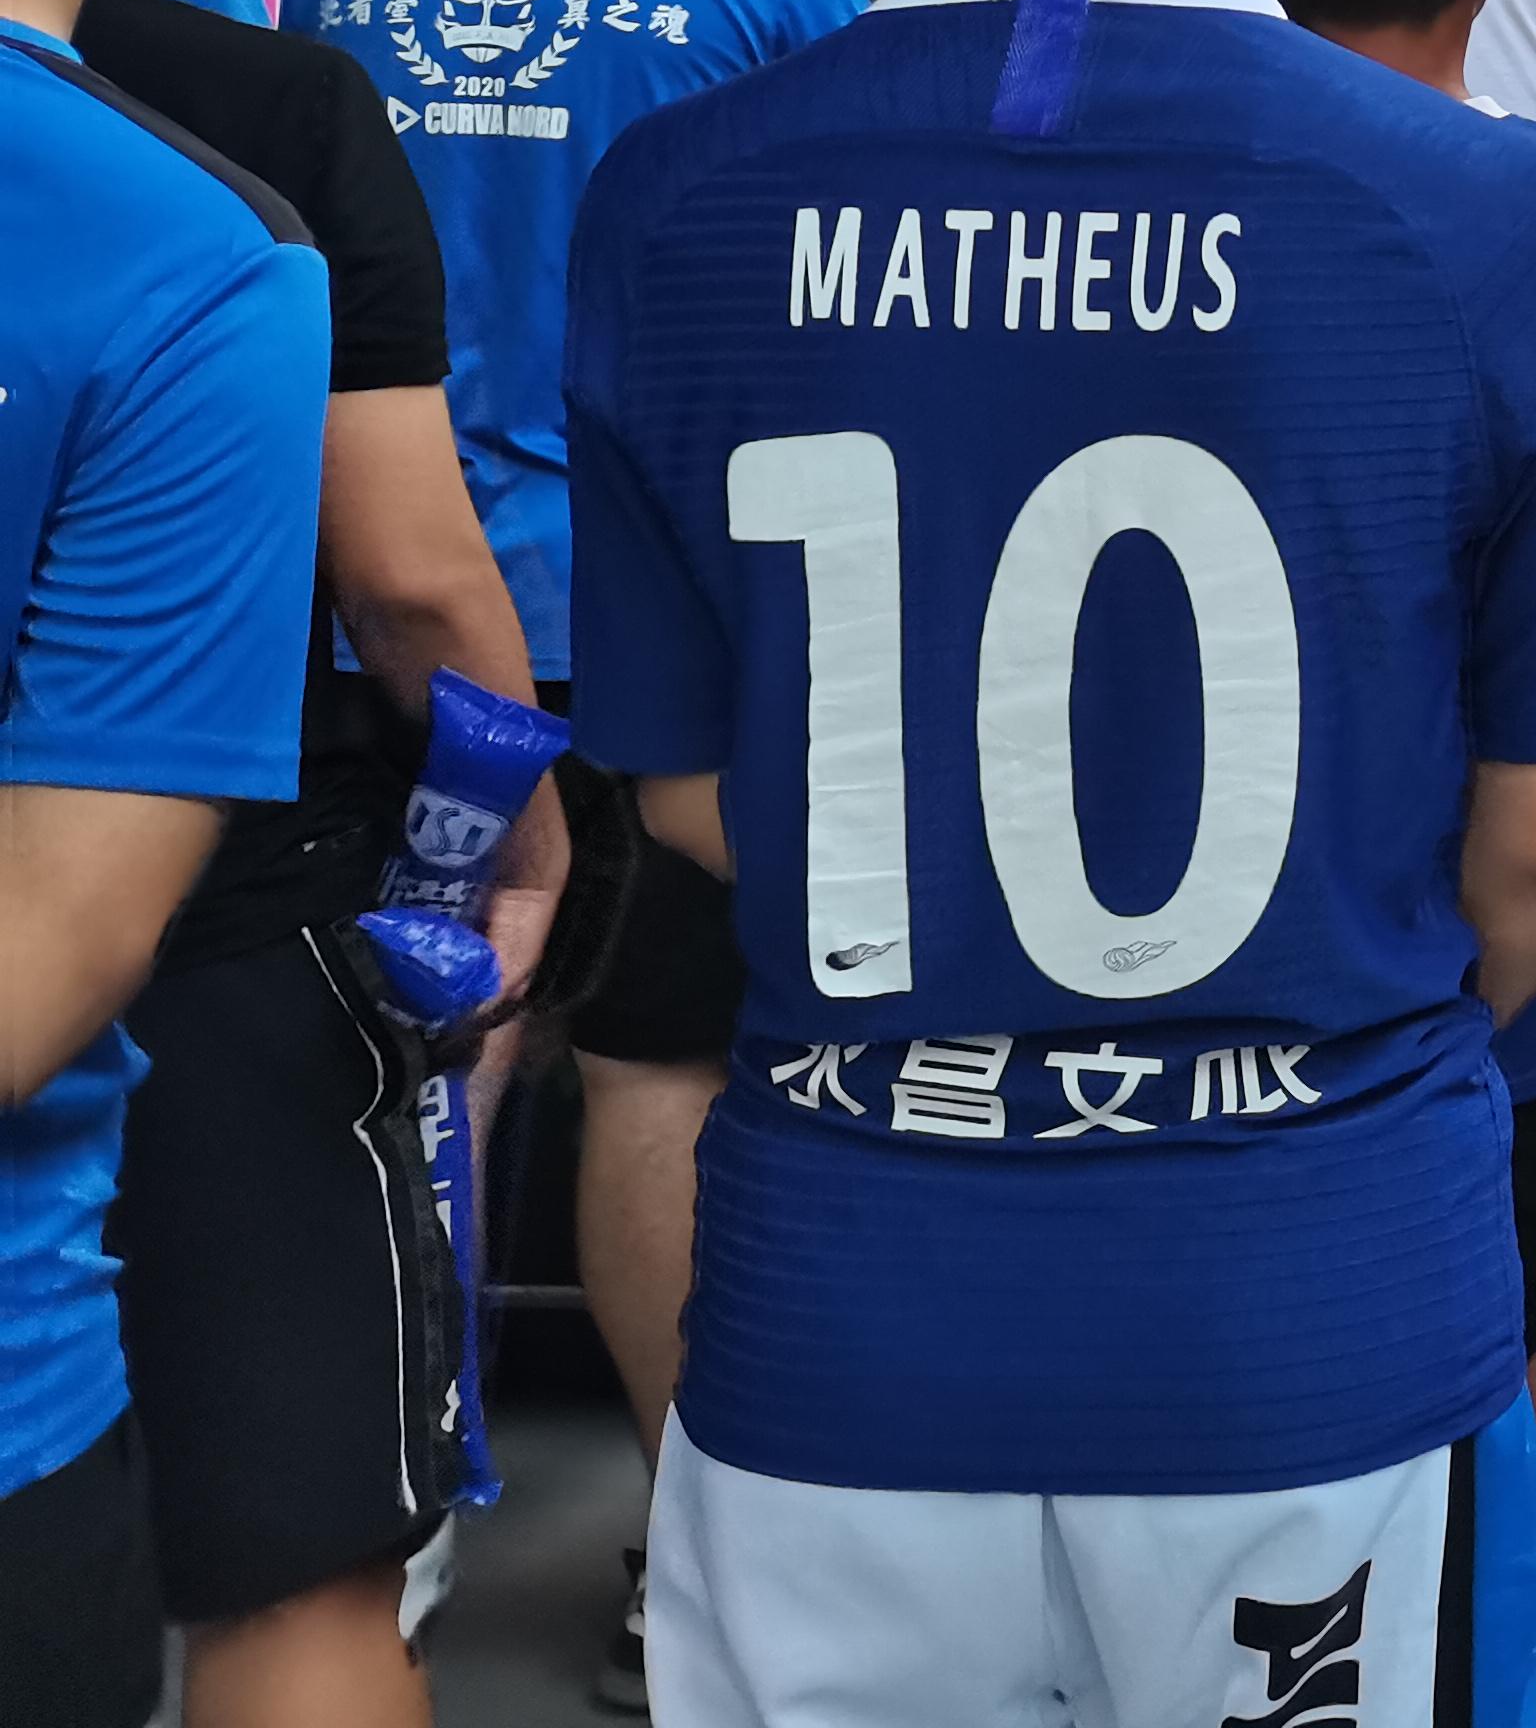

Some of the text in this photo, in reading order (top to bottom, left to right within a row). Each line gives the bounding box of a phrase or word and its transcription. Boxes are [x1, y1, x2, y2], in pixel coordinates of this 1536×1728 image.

[424, 102, 570, 139] CURVA NORD
[453, 75, 506, 98] 2020
[789, 206, 1243, 332] MATHEUS
[727, 430, 1301, 999] 10
